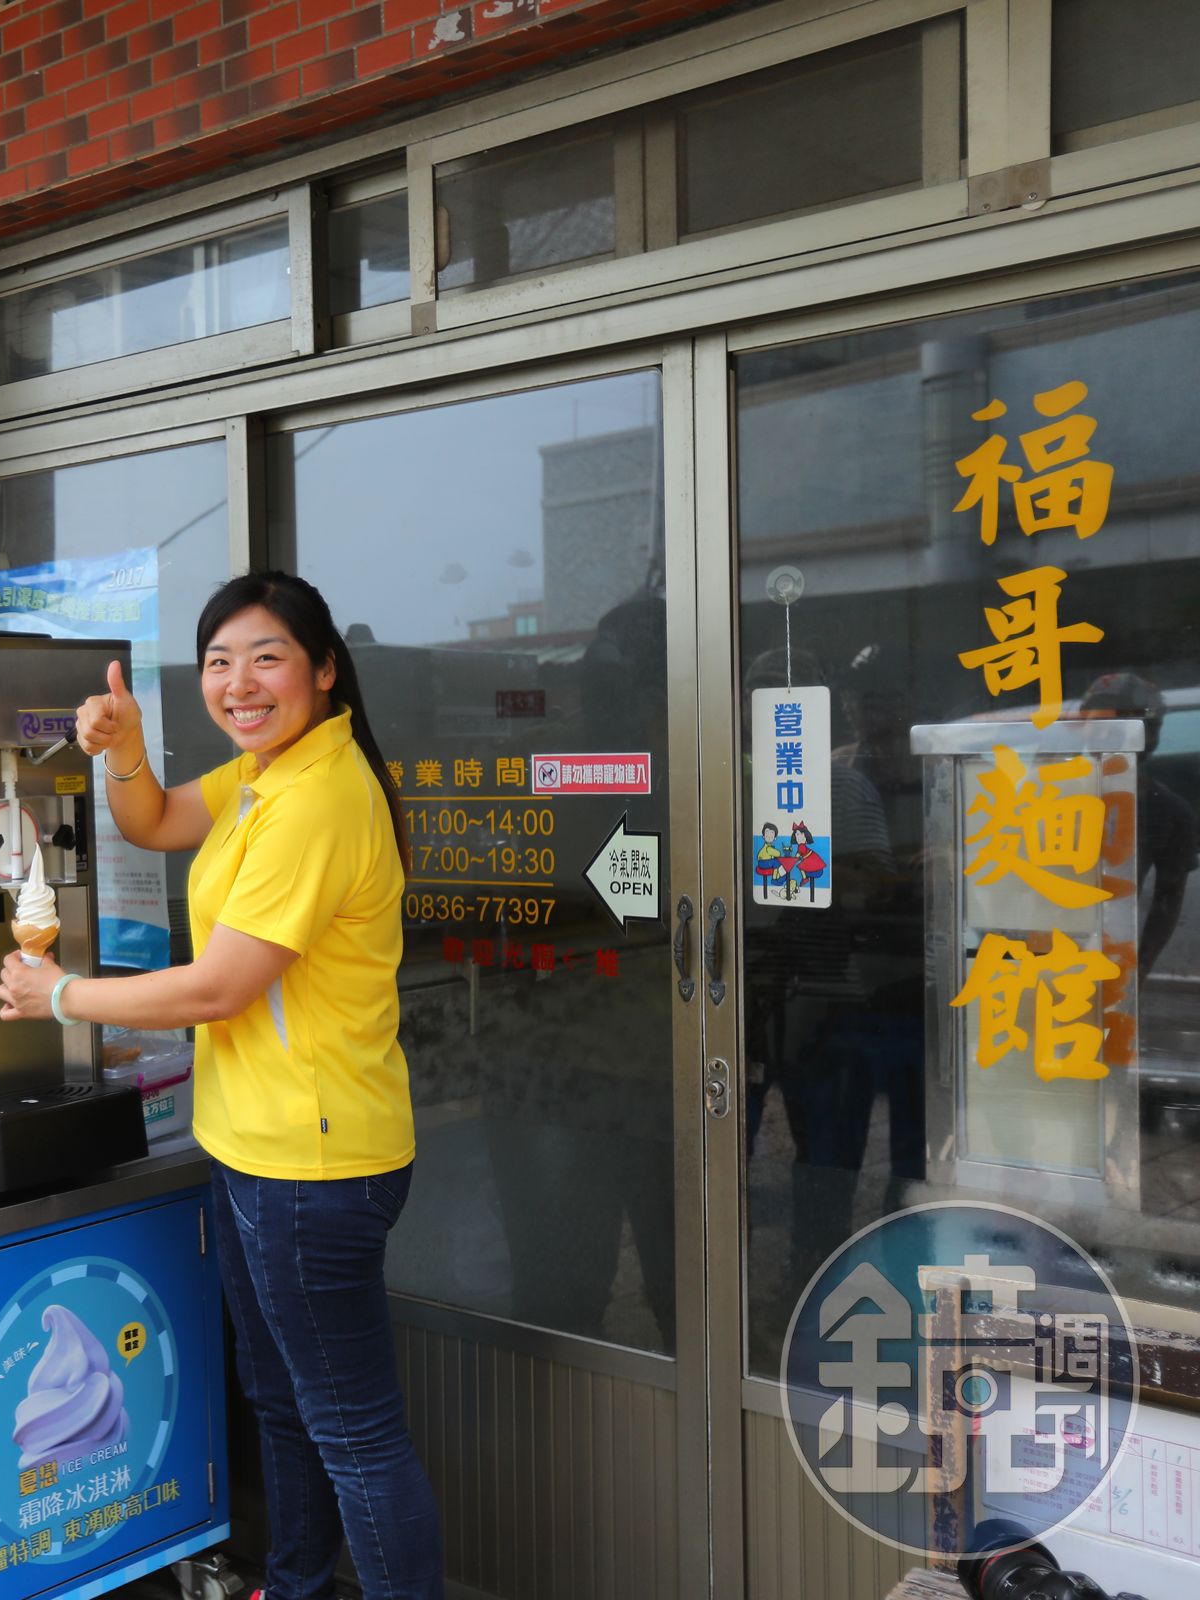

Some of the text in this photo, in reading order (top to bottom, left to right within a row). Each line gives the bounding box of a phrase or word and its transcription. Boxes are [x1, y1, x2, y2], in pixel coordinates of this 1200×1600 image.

[108, 566, 145, 588] 2017
[949, 380, 1121, 1081] 福哥麵館
[775, 703, 803, 813] 營業中
[562, 765, 647, 785] 請勿攜帶寵物進入
[405, 809, 554, 836] 11:00~14:00
[608, 850, 651, 879] 冷氣開放
[609, 881, 653, 896] OPEN
[406, 894, 556, 924] 0836-77397
[2, 1346, 26, 1372] 美味
[19, 1440, 128, 1497] 夏戀 ICE CREAM
[19, 1464, 131, 1529] 霜降冰淇淋
[63, 1477, 181, 1543] 東湧陳高口味
